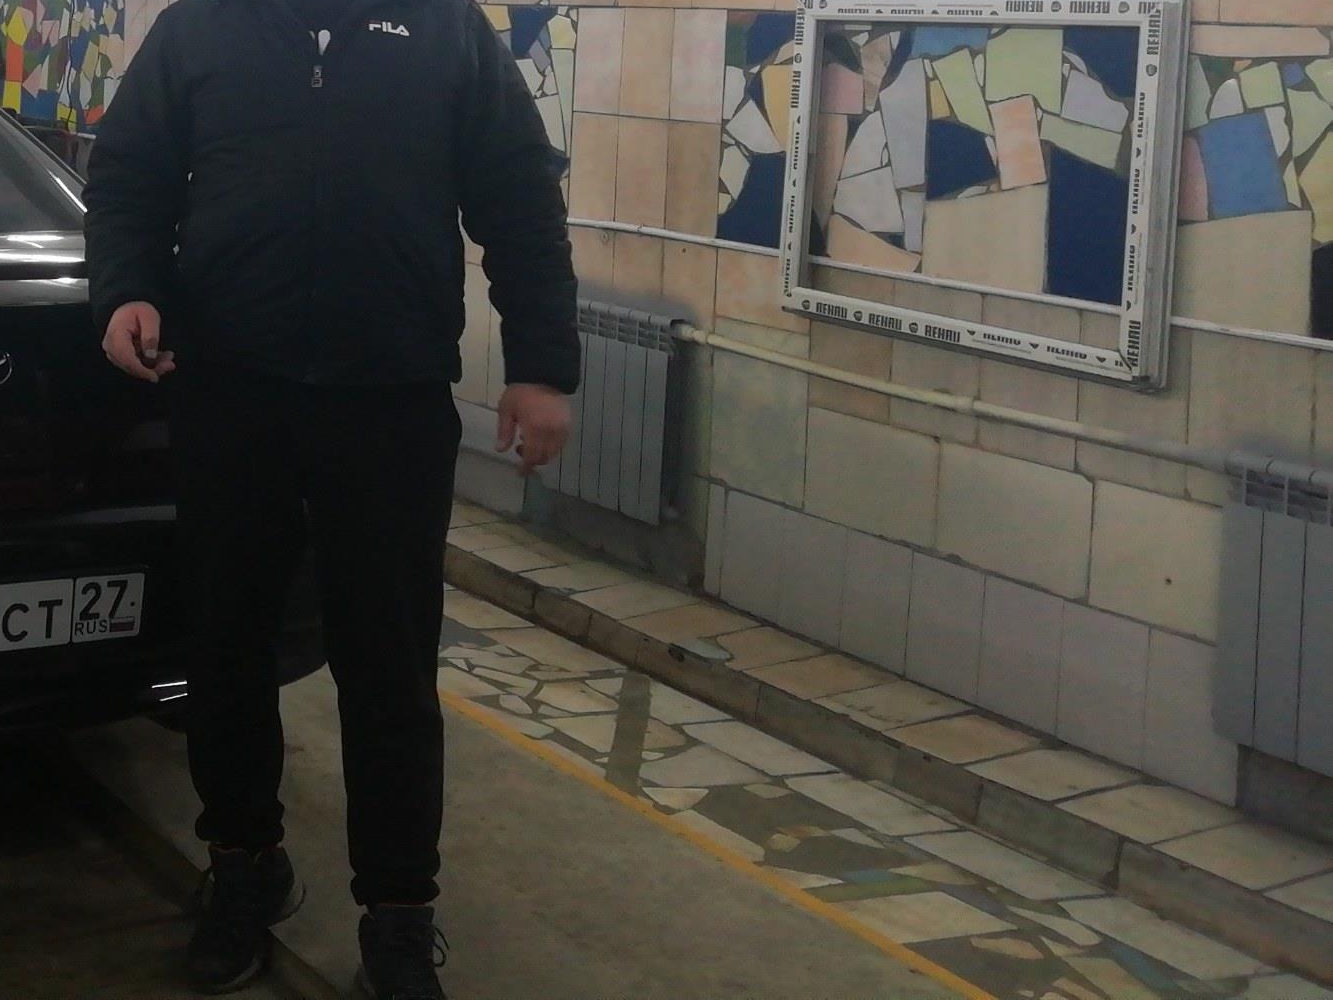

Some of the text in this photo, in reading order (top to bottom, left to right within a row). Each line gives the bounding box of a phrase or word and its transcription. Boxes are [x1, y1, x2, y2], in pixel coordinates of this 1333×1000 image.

[369, 20, 410, 37] FILA
[868, 313, 902, 330] REHAU
[924, 325, 960, 343] REHAU
[79, 579, 128, 621] 27
[74, 619, 108, 637] RUS
